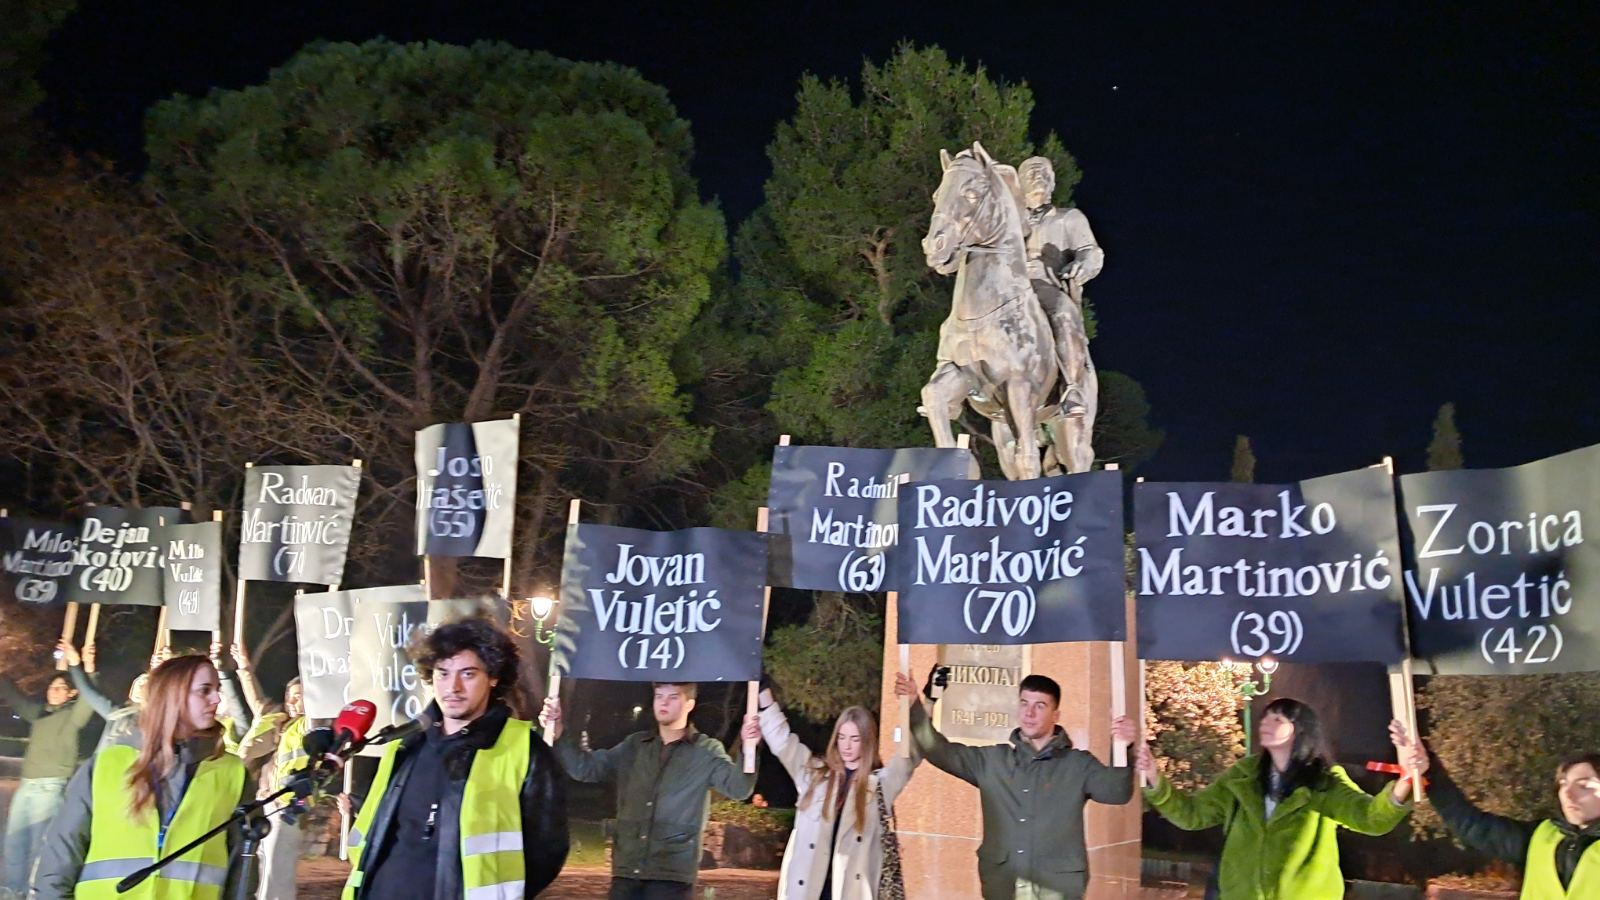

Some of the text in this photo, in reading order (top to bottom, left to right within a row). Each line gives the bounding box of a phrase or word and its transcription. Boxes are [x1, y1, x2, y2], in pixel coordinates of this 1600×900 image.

[81, 517, 150, 548] Dejan
[913, 484, 1074, 537] Radivoje
[1166, 490, 1336, 538] Marko
[1416, 503, 1585, 559] Zorica
[23, 528, 80, 553] Milo
[912, 535, 1088, 586] Marković
[79, 566, 133, 592] (40)
[605, 543, 706, 587] Jovan
[838, 550, 886, 592] (63)
[1137, 548, 1392, 597] Martinović
[587, 588, 722, 635] Vuletić
[963, 586, 1037, 637] (70)
[1404, 567, 1573, 621] Vuletić
[618, 636, 685, 670] (14)
[1230, 610, 1303, 656] (39)
[1480, 624, 1564, 664] (42)
